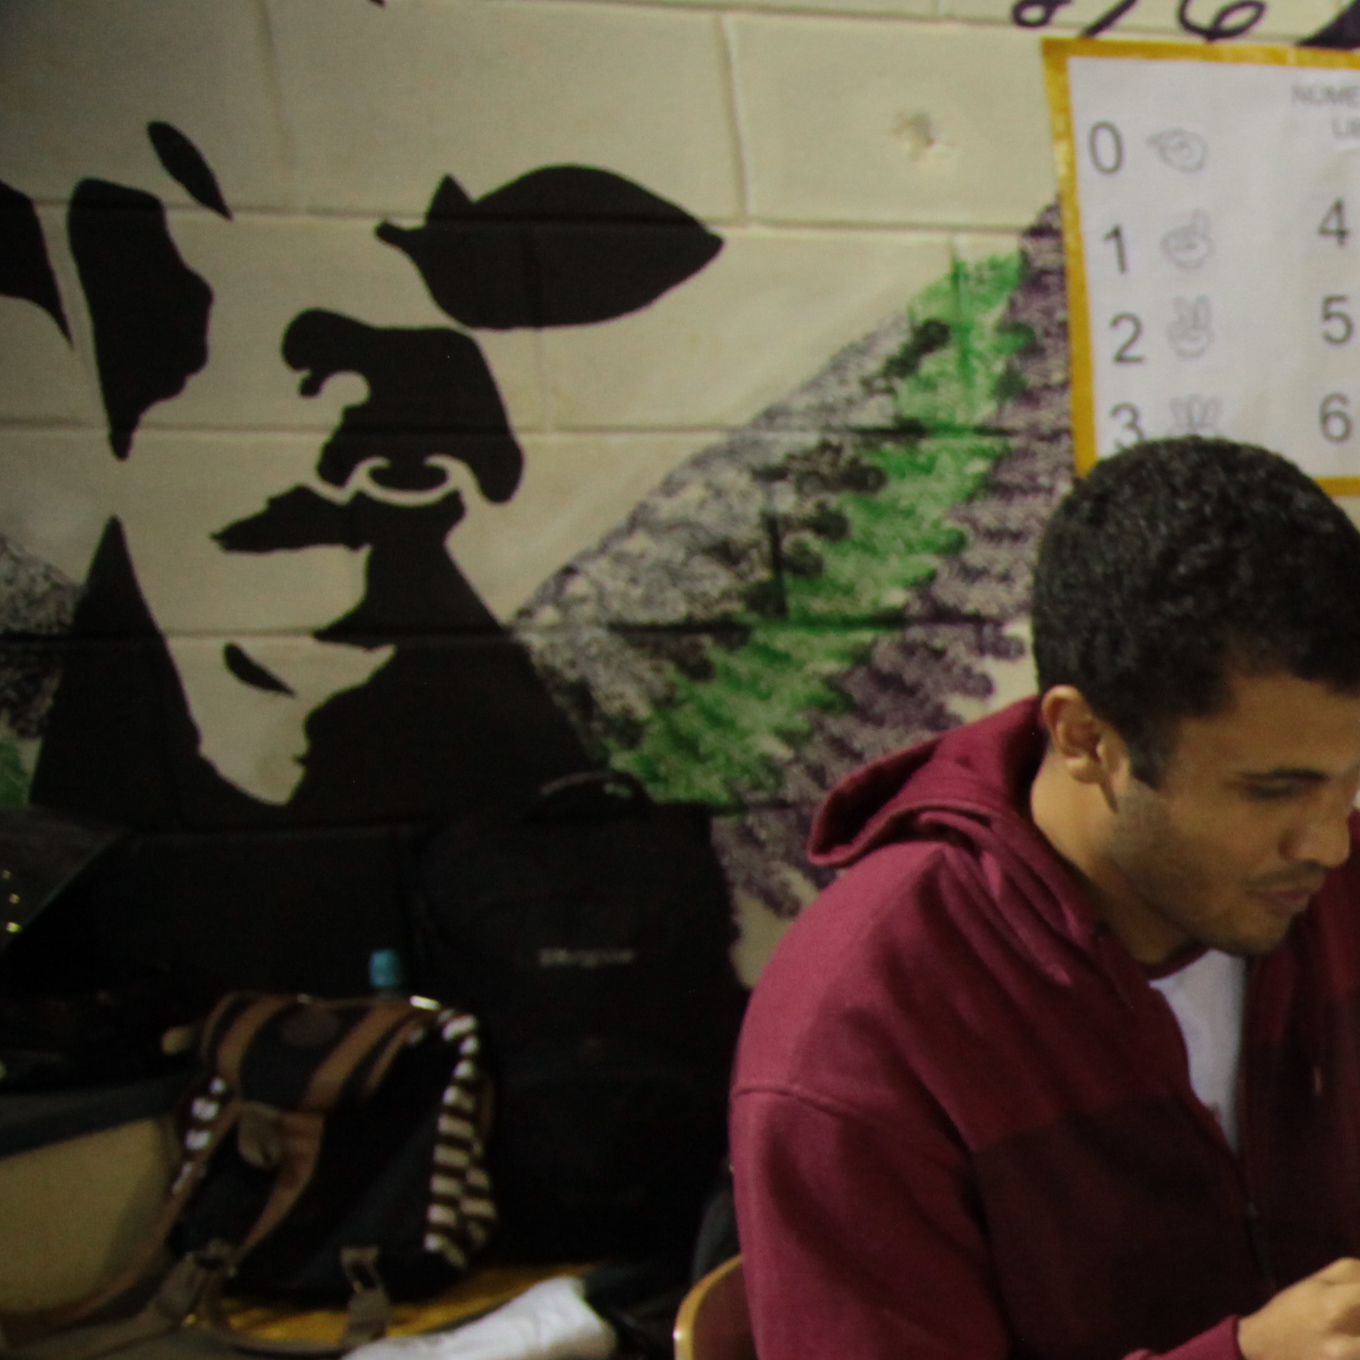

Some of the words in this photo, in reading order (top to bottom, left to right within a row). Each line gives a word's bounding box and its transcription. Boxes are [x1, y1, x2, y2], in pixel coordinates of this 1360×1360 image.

[1088, 120, 1124, 174] 0
[1317, 197, 1351, 247] 4
[1103, 224, 1127, 274] 1
[1109, 311, 1147, 366] 2
[1321, 294, 1355, 346] 5
[1109, 402, 1146, 450] 3
[1318, 391, 1353, 443] 6
